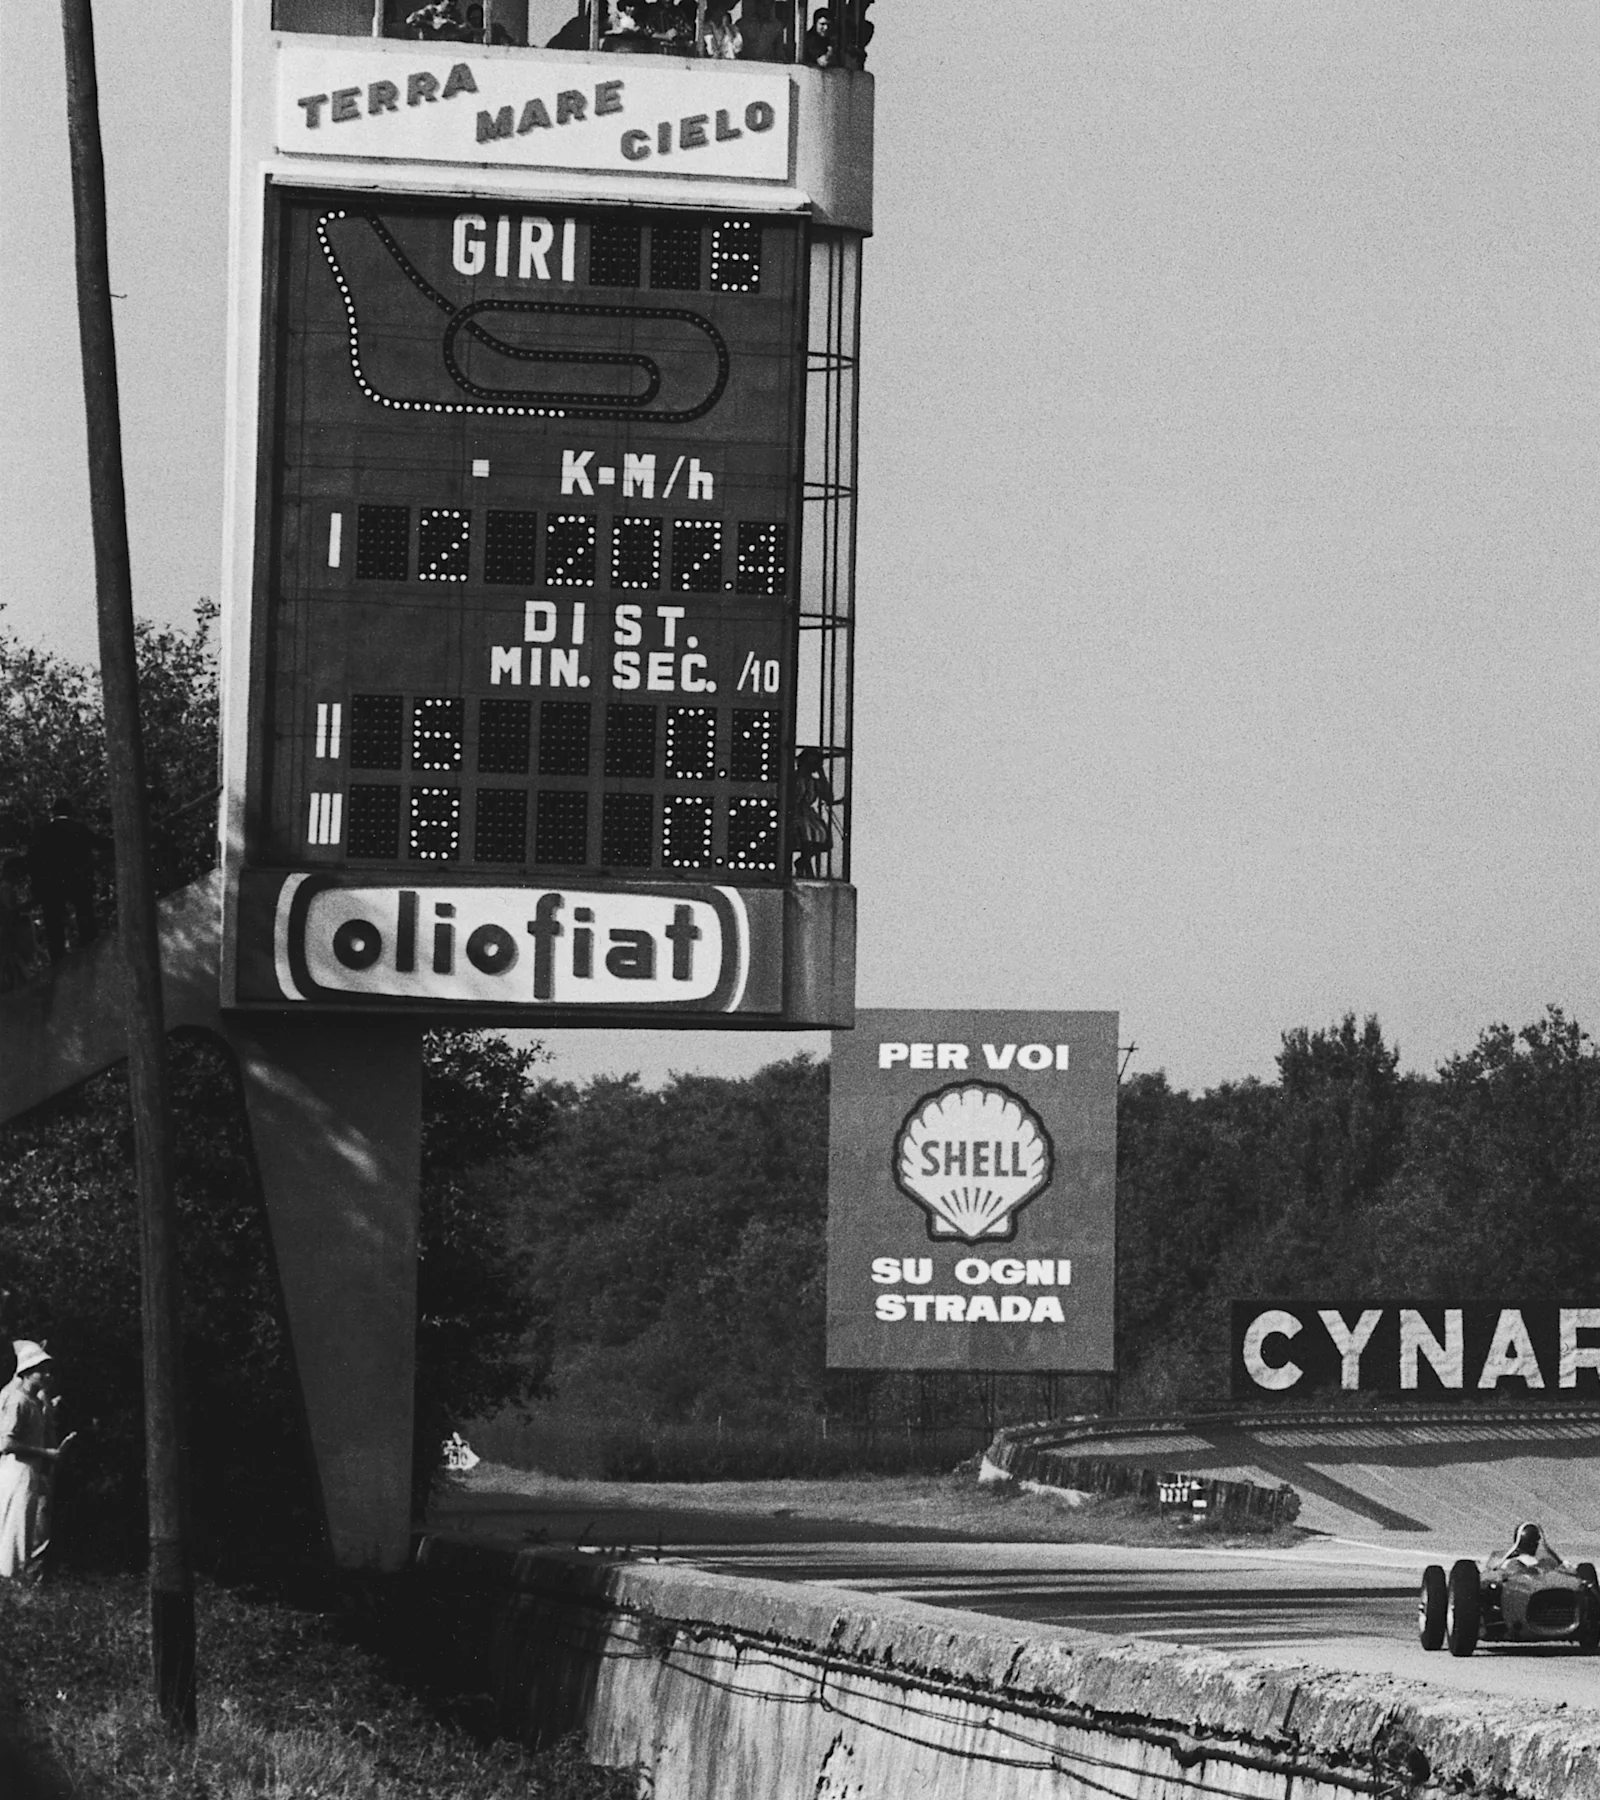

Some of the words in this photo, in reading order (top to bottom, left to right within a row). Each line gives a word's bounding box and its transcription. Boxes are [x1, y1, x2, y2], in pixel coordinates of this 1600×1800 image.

[298, 63, 479, 129] TERRA
[475, 80, 625, 142] MARE
[620, 100, 775, 161] CIELO
[452, 213, 577, 283] GIRI
[711, 221, 759, 291] 6
[419, 510, 469, 581] 2
[491, 646, 590, 688] MIN.
[612, 651, 717, 693] SEC.
[737, 651, 779, 693] /10
[413, 699, 461, 770] 6
[411, 788, 459, 859] 8
[333, 890, 702, 1000] oliofiat
[878, 1042, 970, 1070] PER
[982, 1043, 1069, 1071] VOI
[920, 1140, 1028, 1178] SHELL
[871, 1257, 933, 1285] SU
[954, 1257, 1071, 1285] OGNI
[875, 1294, 1065, 1323] STRADA
